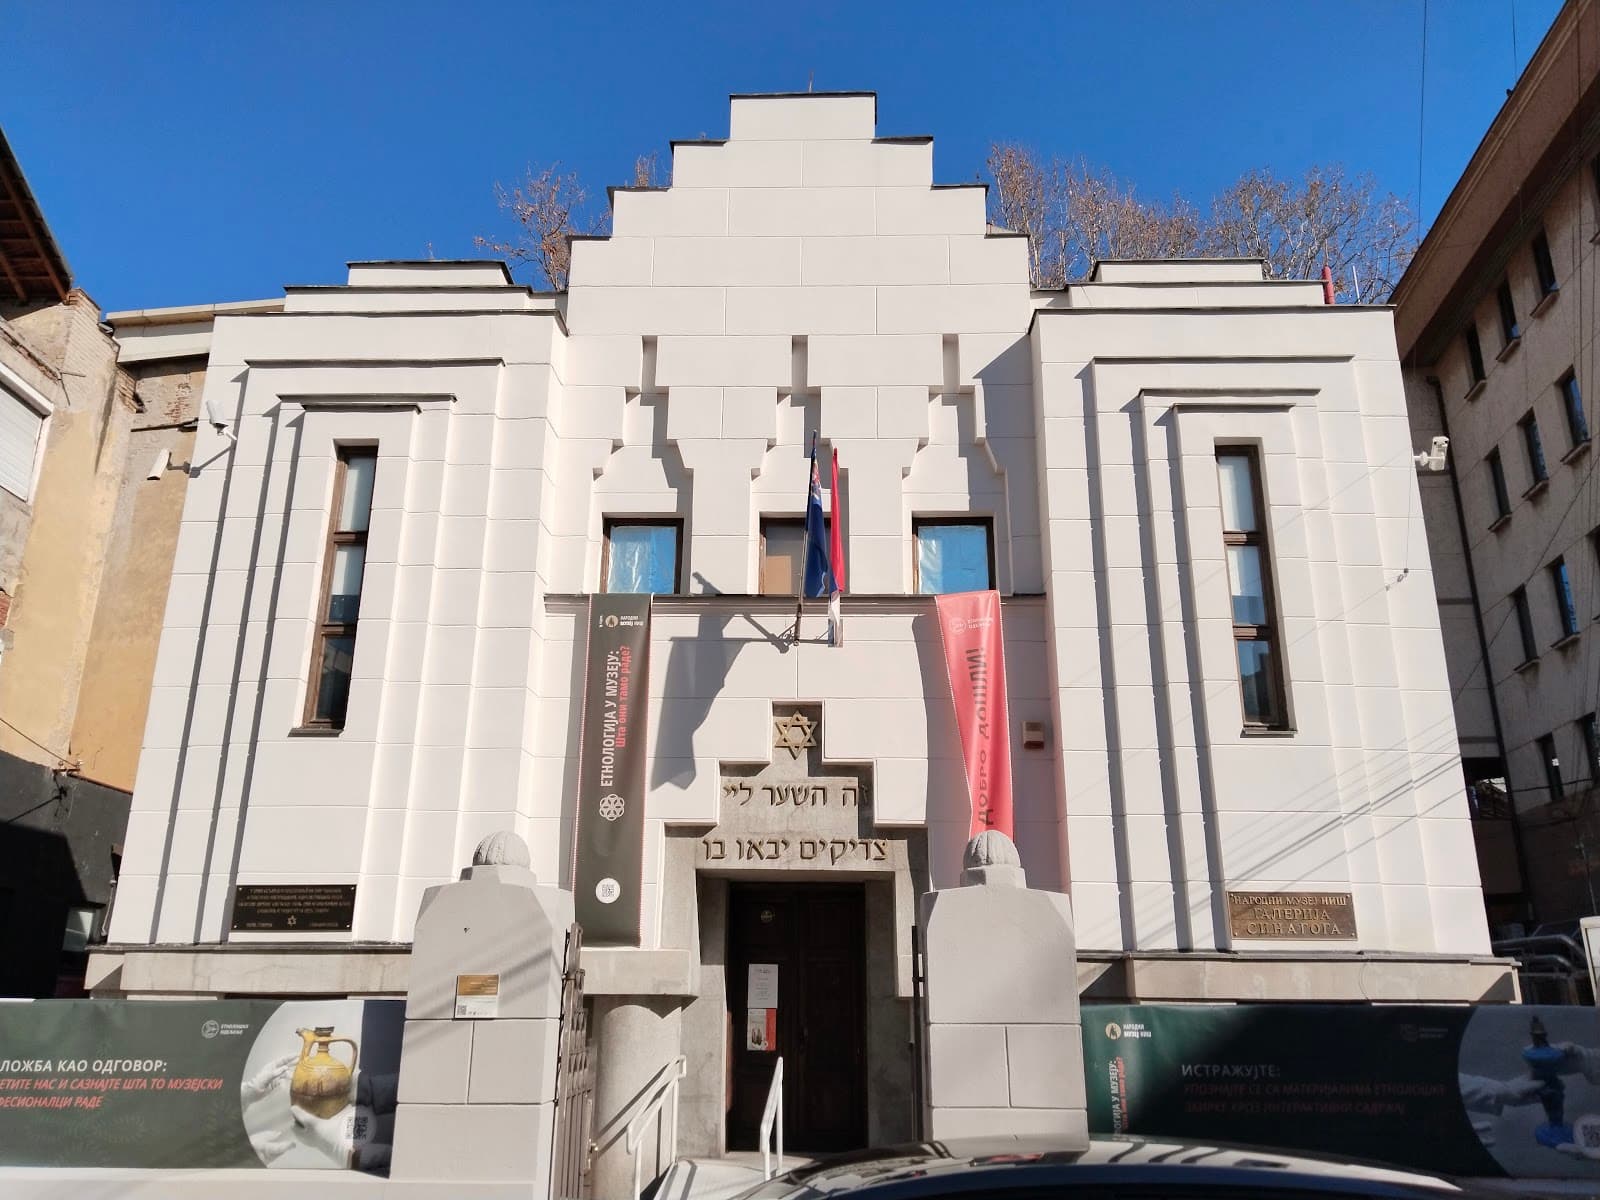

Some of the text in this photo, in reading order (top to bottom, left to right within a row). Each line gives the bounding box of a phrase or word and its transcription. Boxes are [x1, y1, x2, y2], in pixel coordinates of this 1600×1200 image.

[615, 645, 632, 749] Шта они тамо раде?
[600, 650, 621, 787] ЕТНОЛОГИЈА У МУЗЕЈУ:
[761, 784, 828, 807] השער
[977, 750, 994, 826] ДОБРО
[702, 838, 889, 866] צדיקים יבאו בו
[1233, 896, 1347, 906] НАРОДНИ МУЗЕЈ НИШ
[1254, 907, 1330, 920] ГАЛЕРИЈА
[1247, 922, 1341, 935] СИНАГОГА
[0, 1059, 168, 1074] ЛОЖБА КАО ОДГОВОР:
[1181, 1063, 1281, 1079] ИСТРАЖУЈТЕ:
[34, 1078, 57, 1090] НАС
[58, 1078, 69, 1090] И
[70, 1078, 121, 1092] САЗНАЈТЕ
[122, 1078, 148, 1090] ШТА
[150, 1078, 166, 1090] ТО
[167, 1078, 224, 1092] МУЗЕЈСКИ
[1108, 1060, 1119, 1094] МУЗЕЈУ:
[74, 1096, 104, 1109] РАДЕ
